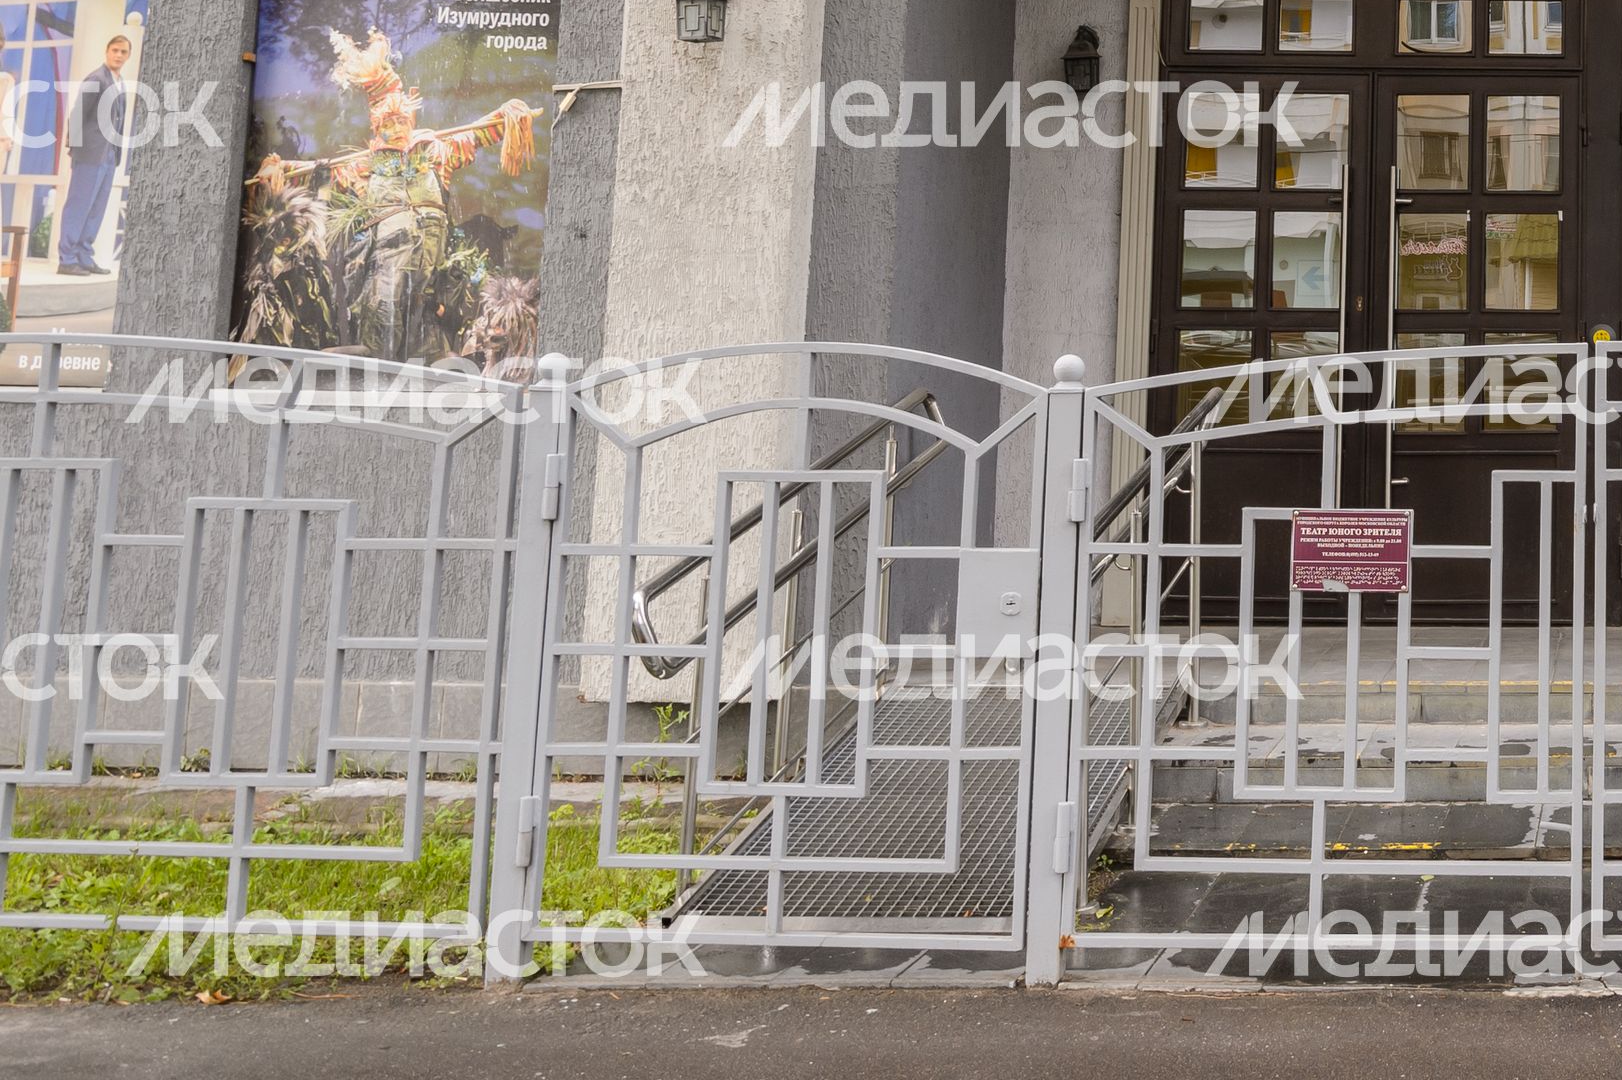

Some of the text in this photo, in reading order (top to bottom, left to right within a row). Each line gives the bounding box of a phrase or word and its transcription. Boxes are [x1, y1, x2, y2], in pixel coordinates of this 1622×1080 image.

[437, 6, 550, 29] Изумрудного
[486, 35, 548, 52] города
[30, 355, 101, 371] девне
[1300, 527, 1402, 536] ТЕАТР ЮНОГО ЗРИТЕЛЯ
